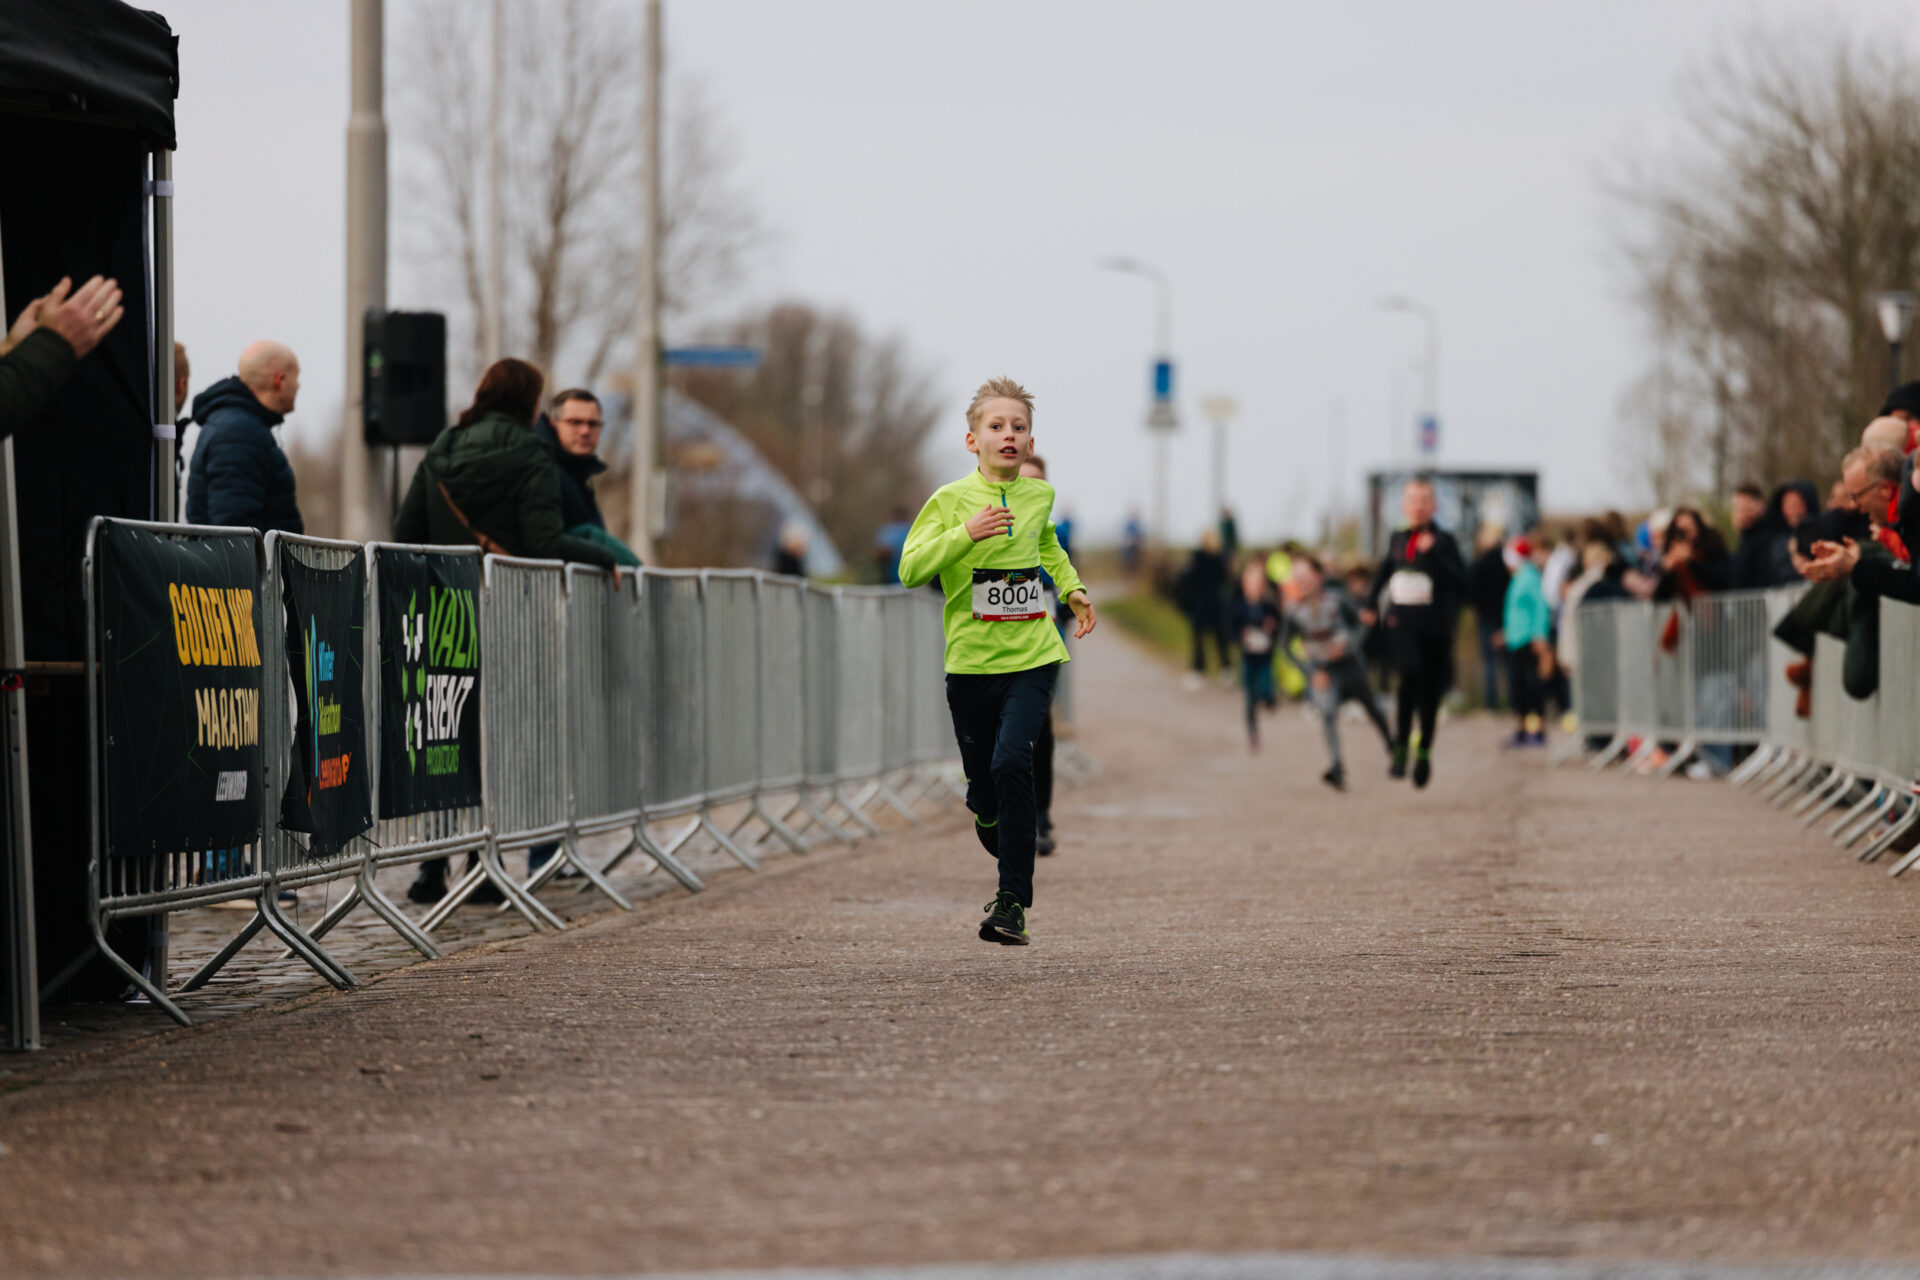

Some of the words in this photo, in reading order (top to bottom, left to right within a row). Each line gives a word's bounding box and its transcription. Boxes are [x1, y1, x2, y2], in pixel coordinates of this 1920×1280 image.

[169, 582, 237, 667] GOLDEN
[429, 585, 477, 669] VALK
[988, 585, 1038, 605] 8004
[195, 687, 259, 751] MARATHON
[426, 674, 474, 740] EVENT
